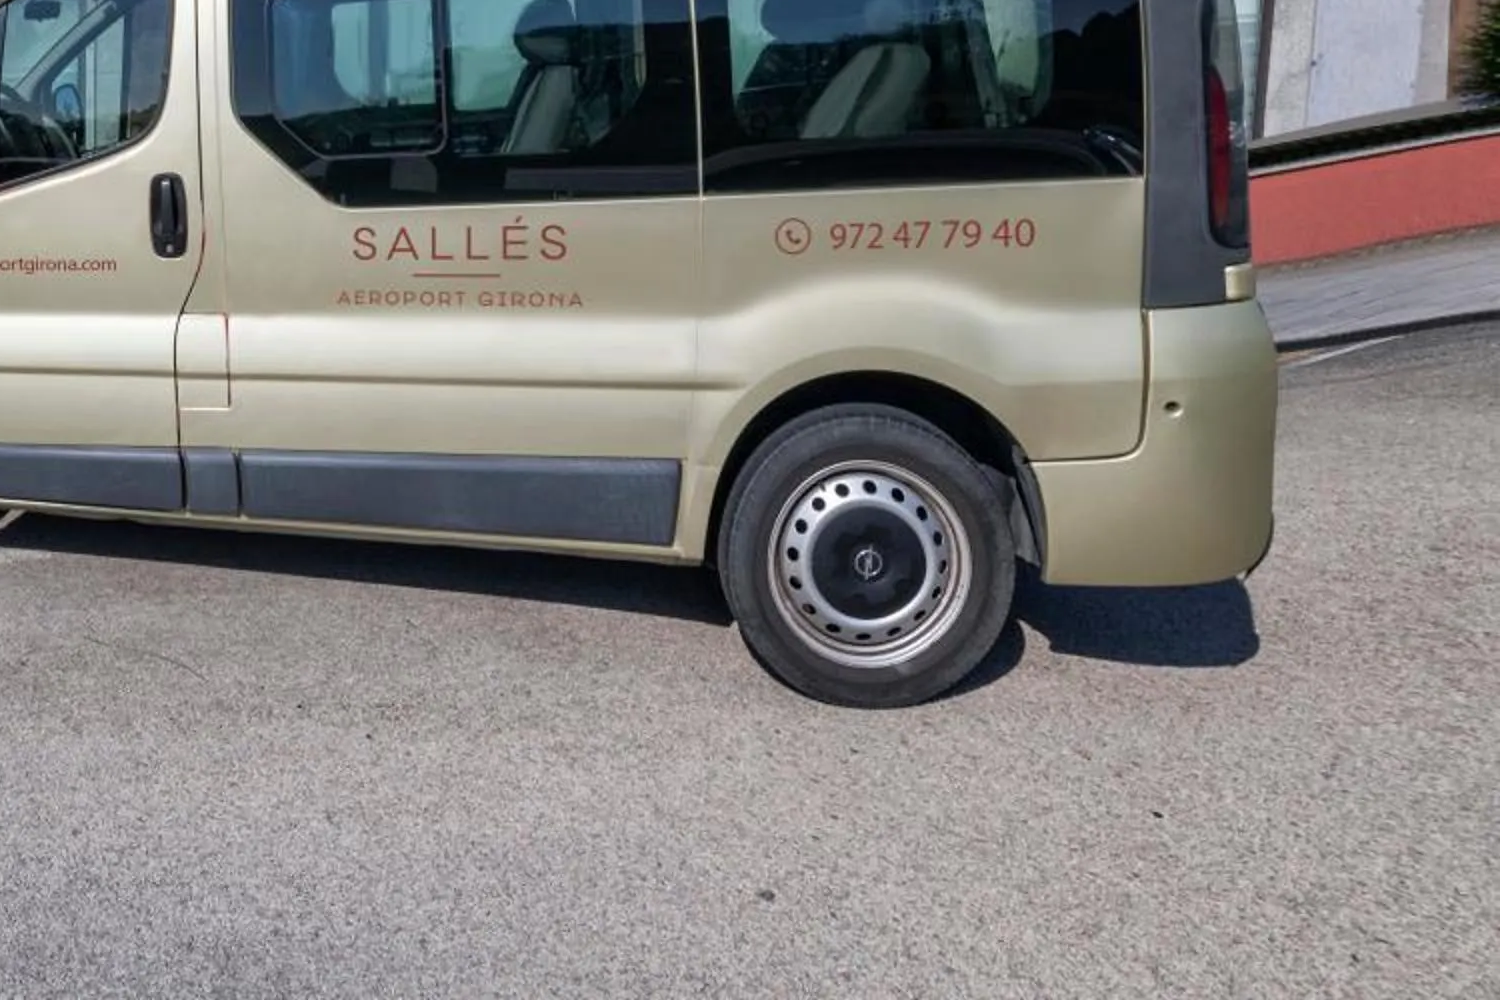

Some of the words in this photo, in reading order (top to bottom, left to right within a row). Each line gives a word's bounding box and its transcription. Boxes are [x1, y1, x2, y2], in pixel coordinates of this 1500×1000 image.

[351, 215, 569, 261] SALLÉS
[829, 222, 884, 249] 972
[892, 221, 931, 248] 47
[940, 219, 982, 248] 79
[992, 218, 1035, 247] 40
[336, 291, 466, 306] AEROPORT
[478, 291, 583, 308] GIRONA
